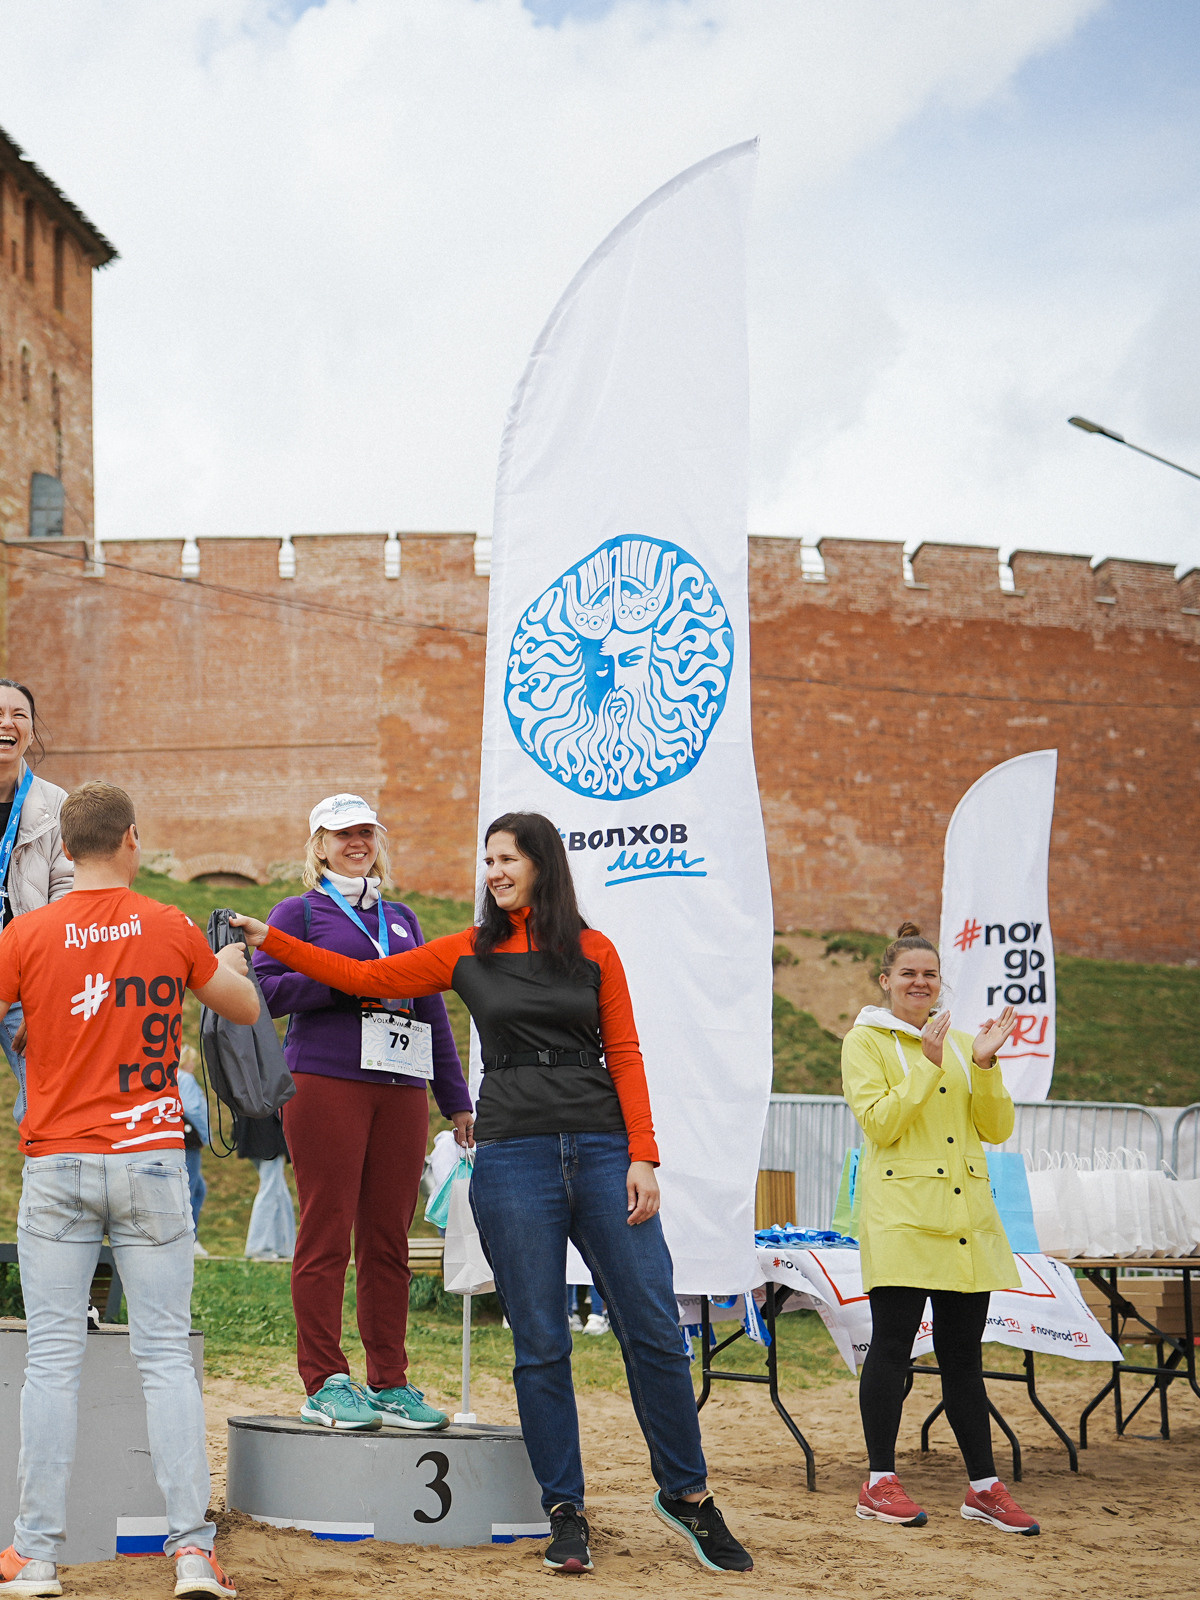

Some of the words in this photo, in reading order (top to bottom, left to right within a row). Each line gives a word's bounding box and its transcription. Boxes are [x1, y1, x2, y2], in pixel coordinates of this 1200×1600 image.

[607, 848, 705, 872] мен
[65, 914, 142, 949] Дубовой
[1004, 949, 1045, 979] go
[987, 971, 1046, 1005] rod
[389, 1031, 410, 1051] 79
[980, 1014, 1049, 1046] RI
[413, 1450, 452, 1524] 3
